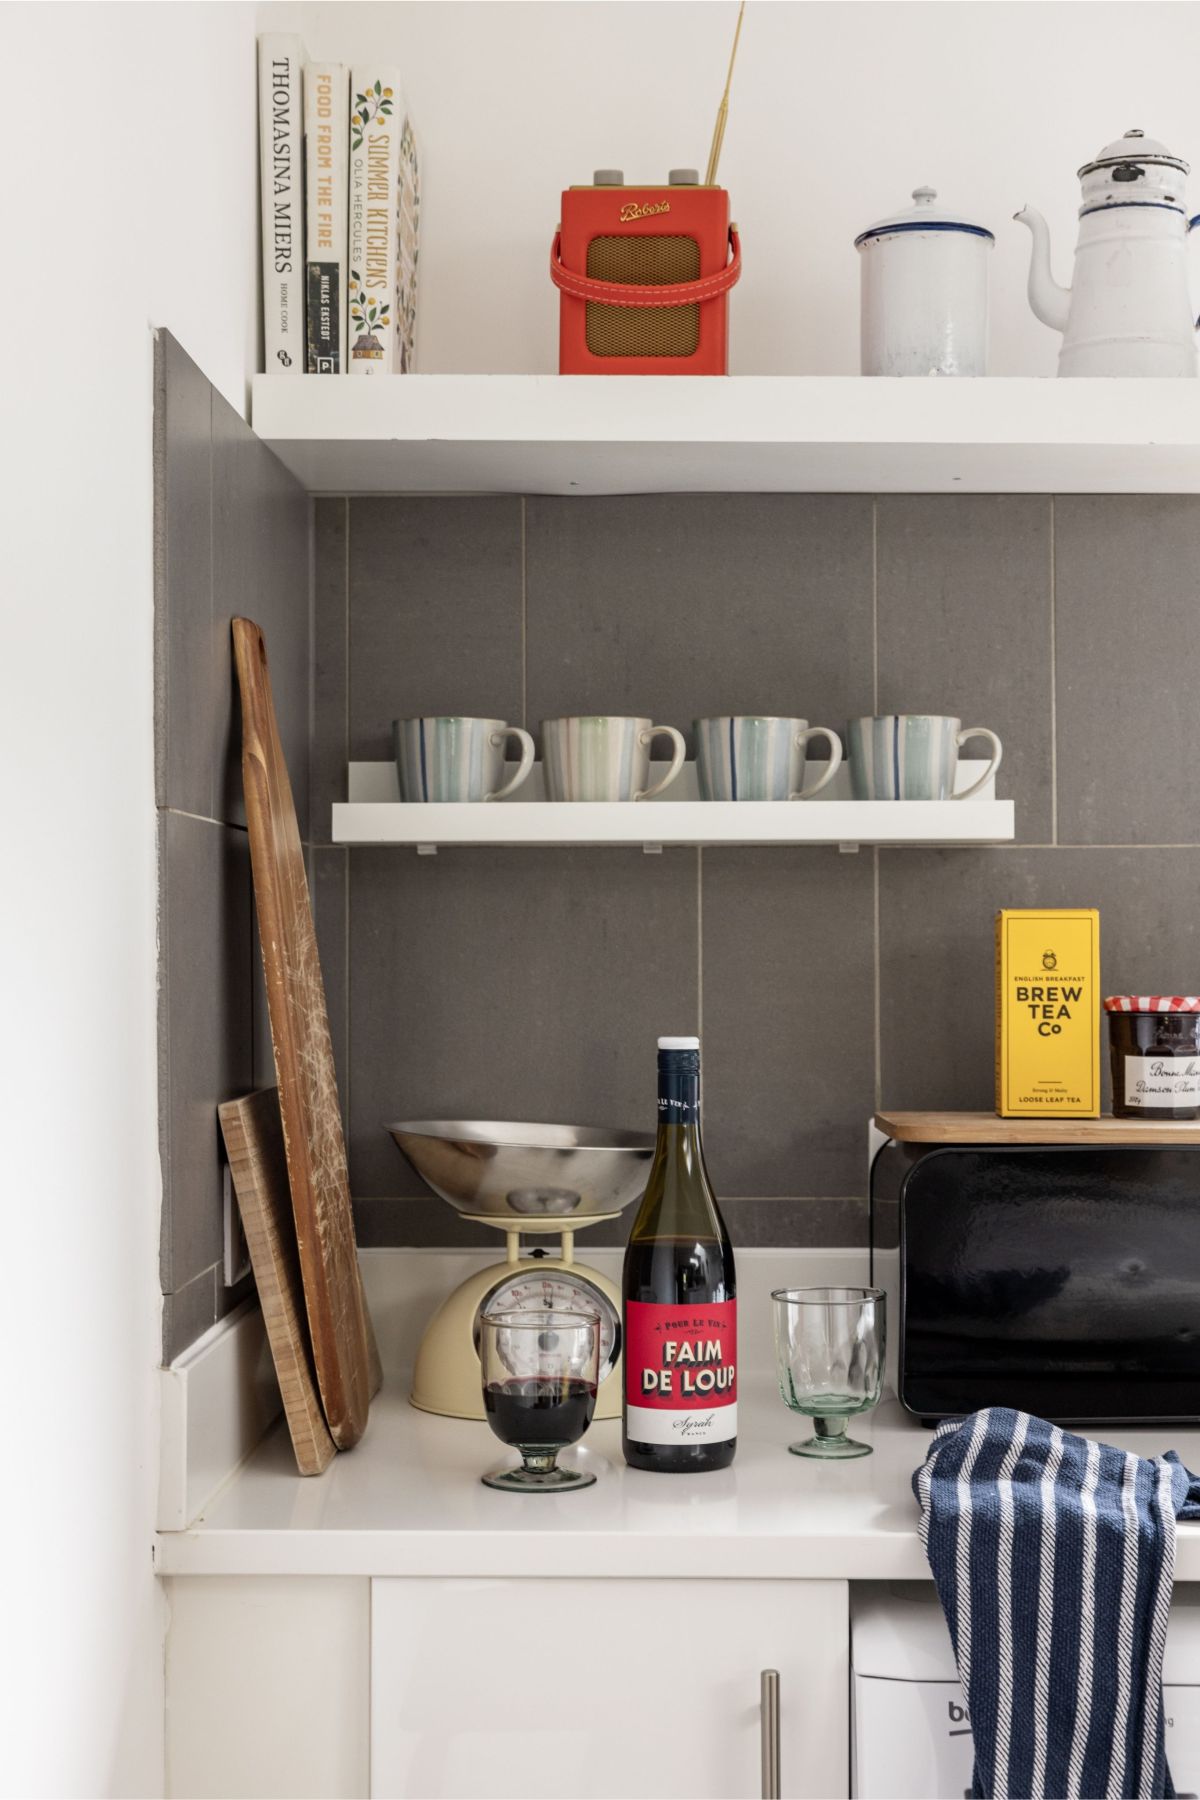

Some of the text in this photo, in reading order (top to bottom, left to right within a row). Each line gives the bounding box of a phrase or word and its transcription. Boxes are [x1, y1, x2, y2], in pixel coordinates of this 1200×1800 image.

[272, 57, 292, 273] THOMASINA MIERS
[317, 74, 332, 248] FOOD FROM THE FIRE
[352, 158, 363, 262] OLIA HERCULES
[620, 200, 670, 222] Roberts
[280, 283, 289, 334] HOME COOK
[320, 275, 330, 341] NIKLAS EKSTEDT
[1016, 987, 1082, 1002] BREW
[1028, 1004, 1071, 1019] TEA
[1038, 1021, 1062, 1037] Co
[664, 1339, 722, 1364] FAIM
[642, 1365, 735, 1393] DE LOUP
[672, 1413, 715, 1434] Syrah
